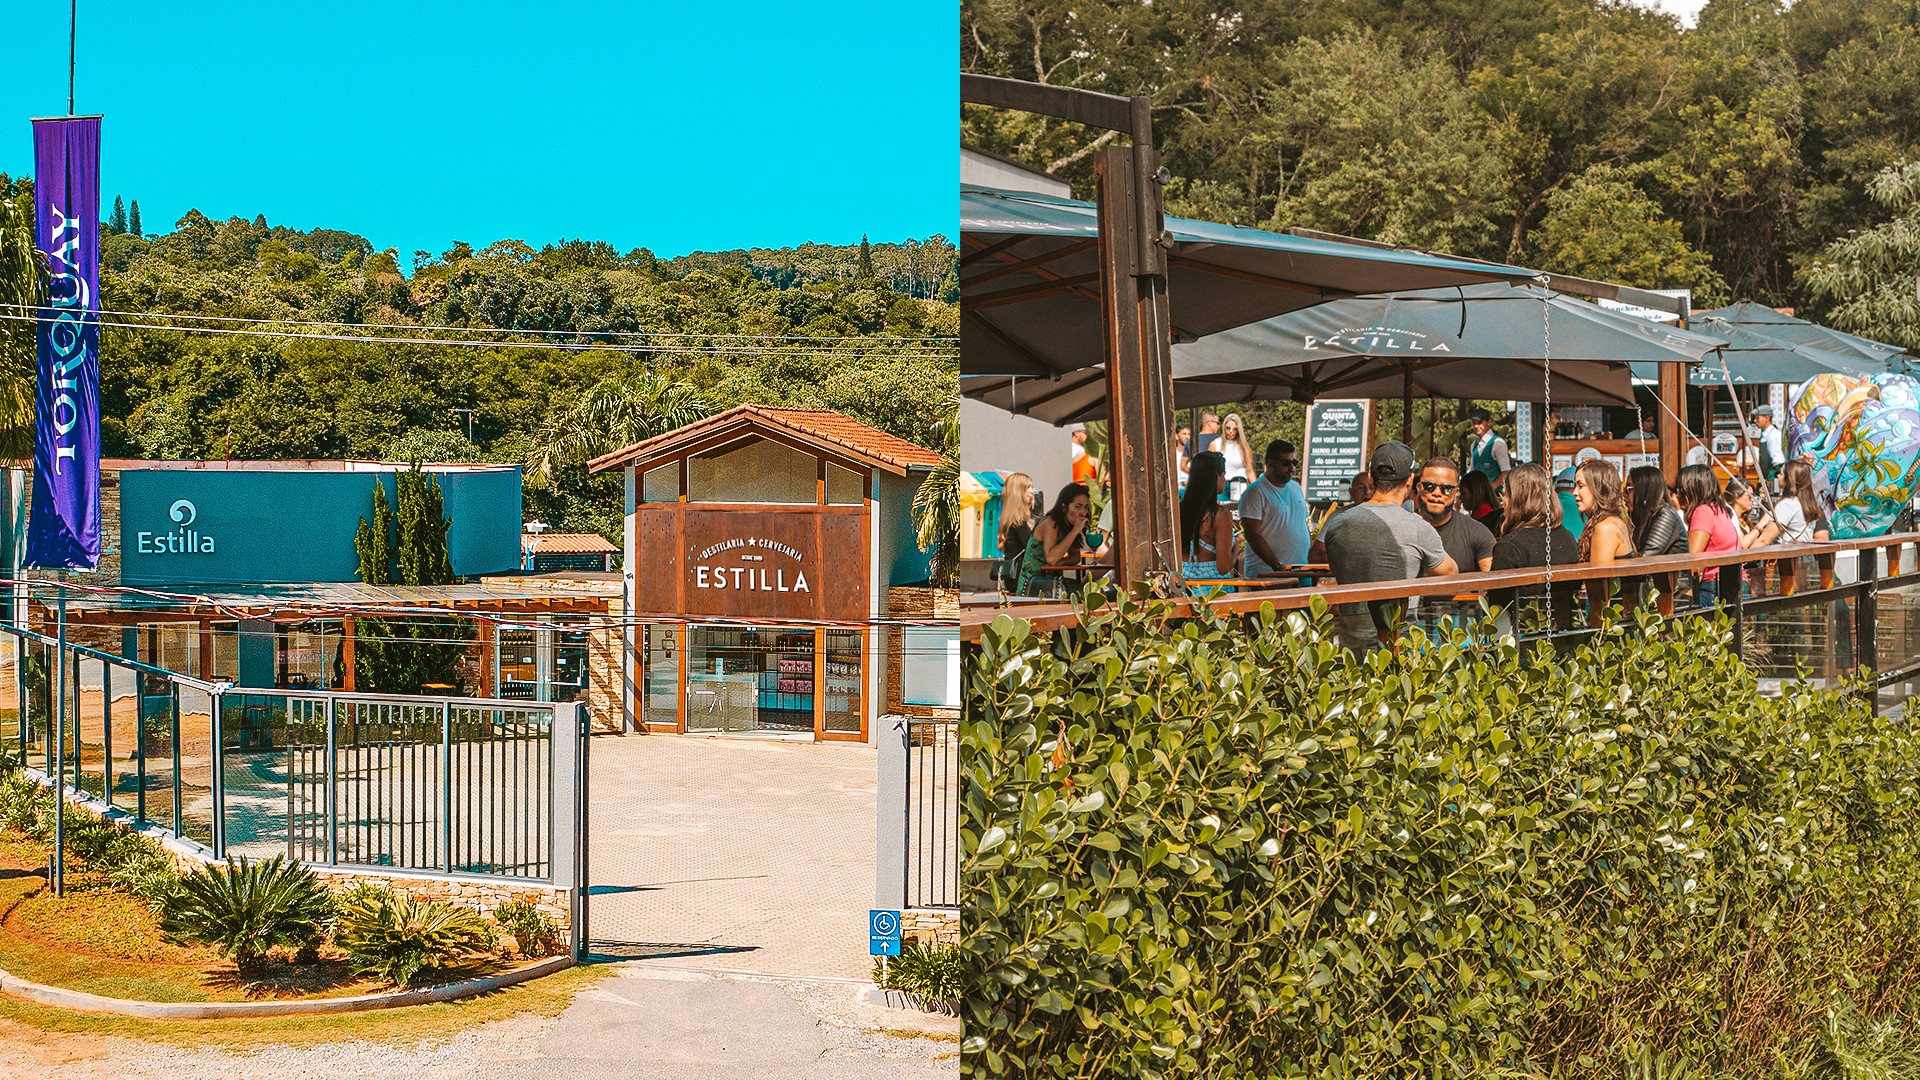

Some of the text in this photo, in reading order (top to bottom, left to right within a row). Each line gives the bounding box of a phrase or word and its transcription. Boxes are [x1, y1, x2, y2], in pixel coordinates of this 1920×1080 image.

[52, 203, 89, 475] TORQUAY
[1322, 412, 1356, 420] QUINTA
[137, 528, 215, 554] Estilla
[701, 538, 803, 562] DESTILARIA CERVEJARIA
[696, 566, 810, 593] ESTILLA
